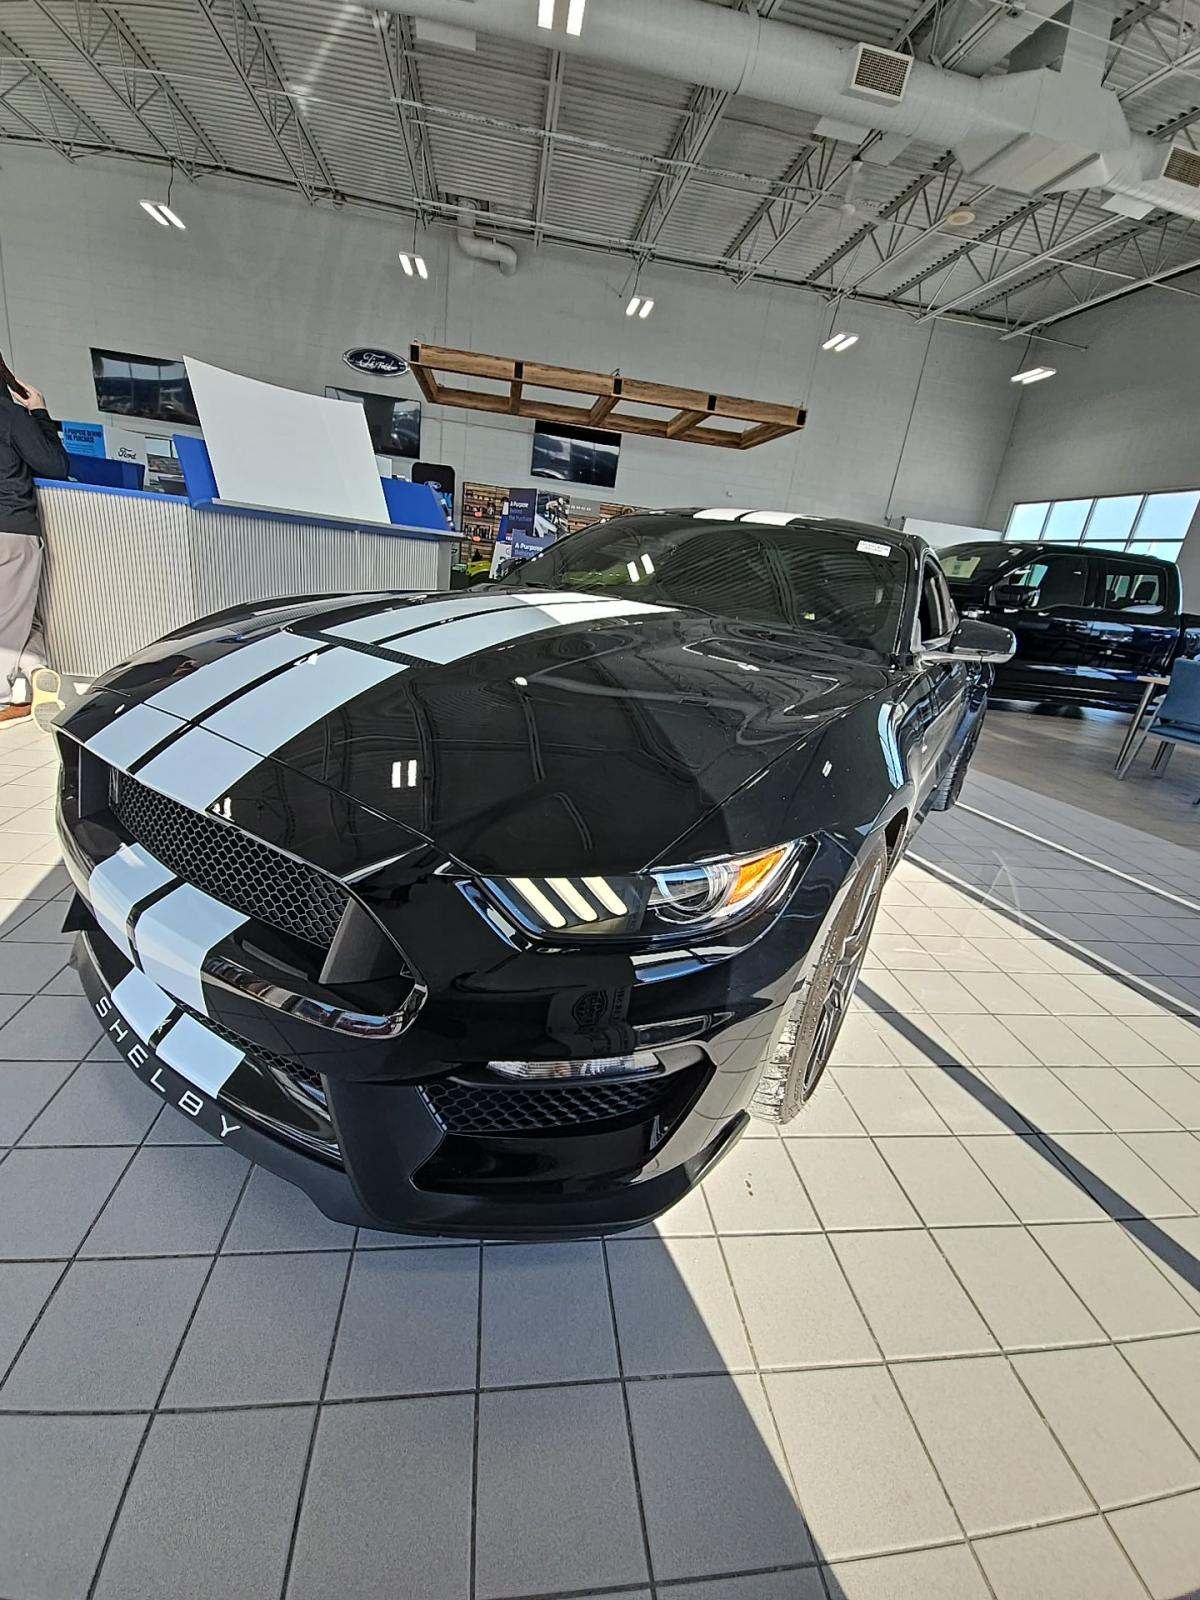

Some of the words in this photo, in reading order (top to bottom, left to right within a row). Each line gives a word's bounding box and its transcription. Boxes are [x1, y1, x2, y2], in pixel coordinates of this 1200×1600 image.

[353, 352, 399, 371] Ford
[118, 447, 136, 459] Ford
[520, 543, 543, 552] Purpose
[96, 996, 241, 1137] SHELBY
